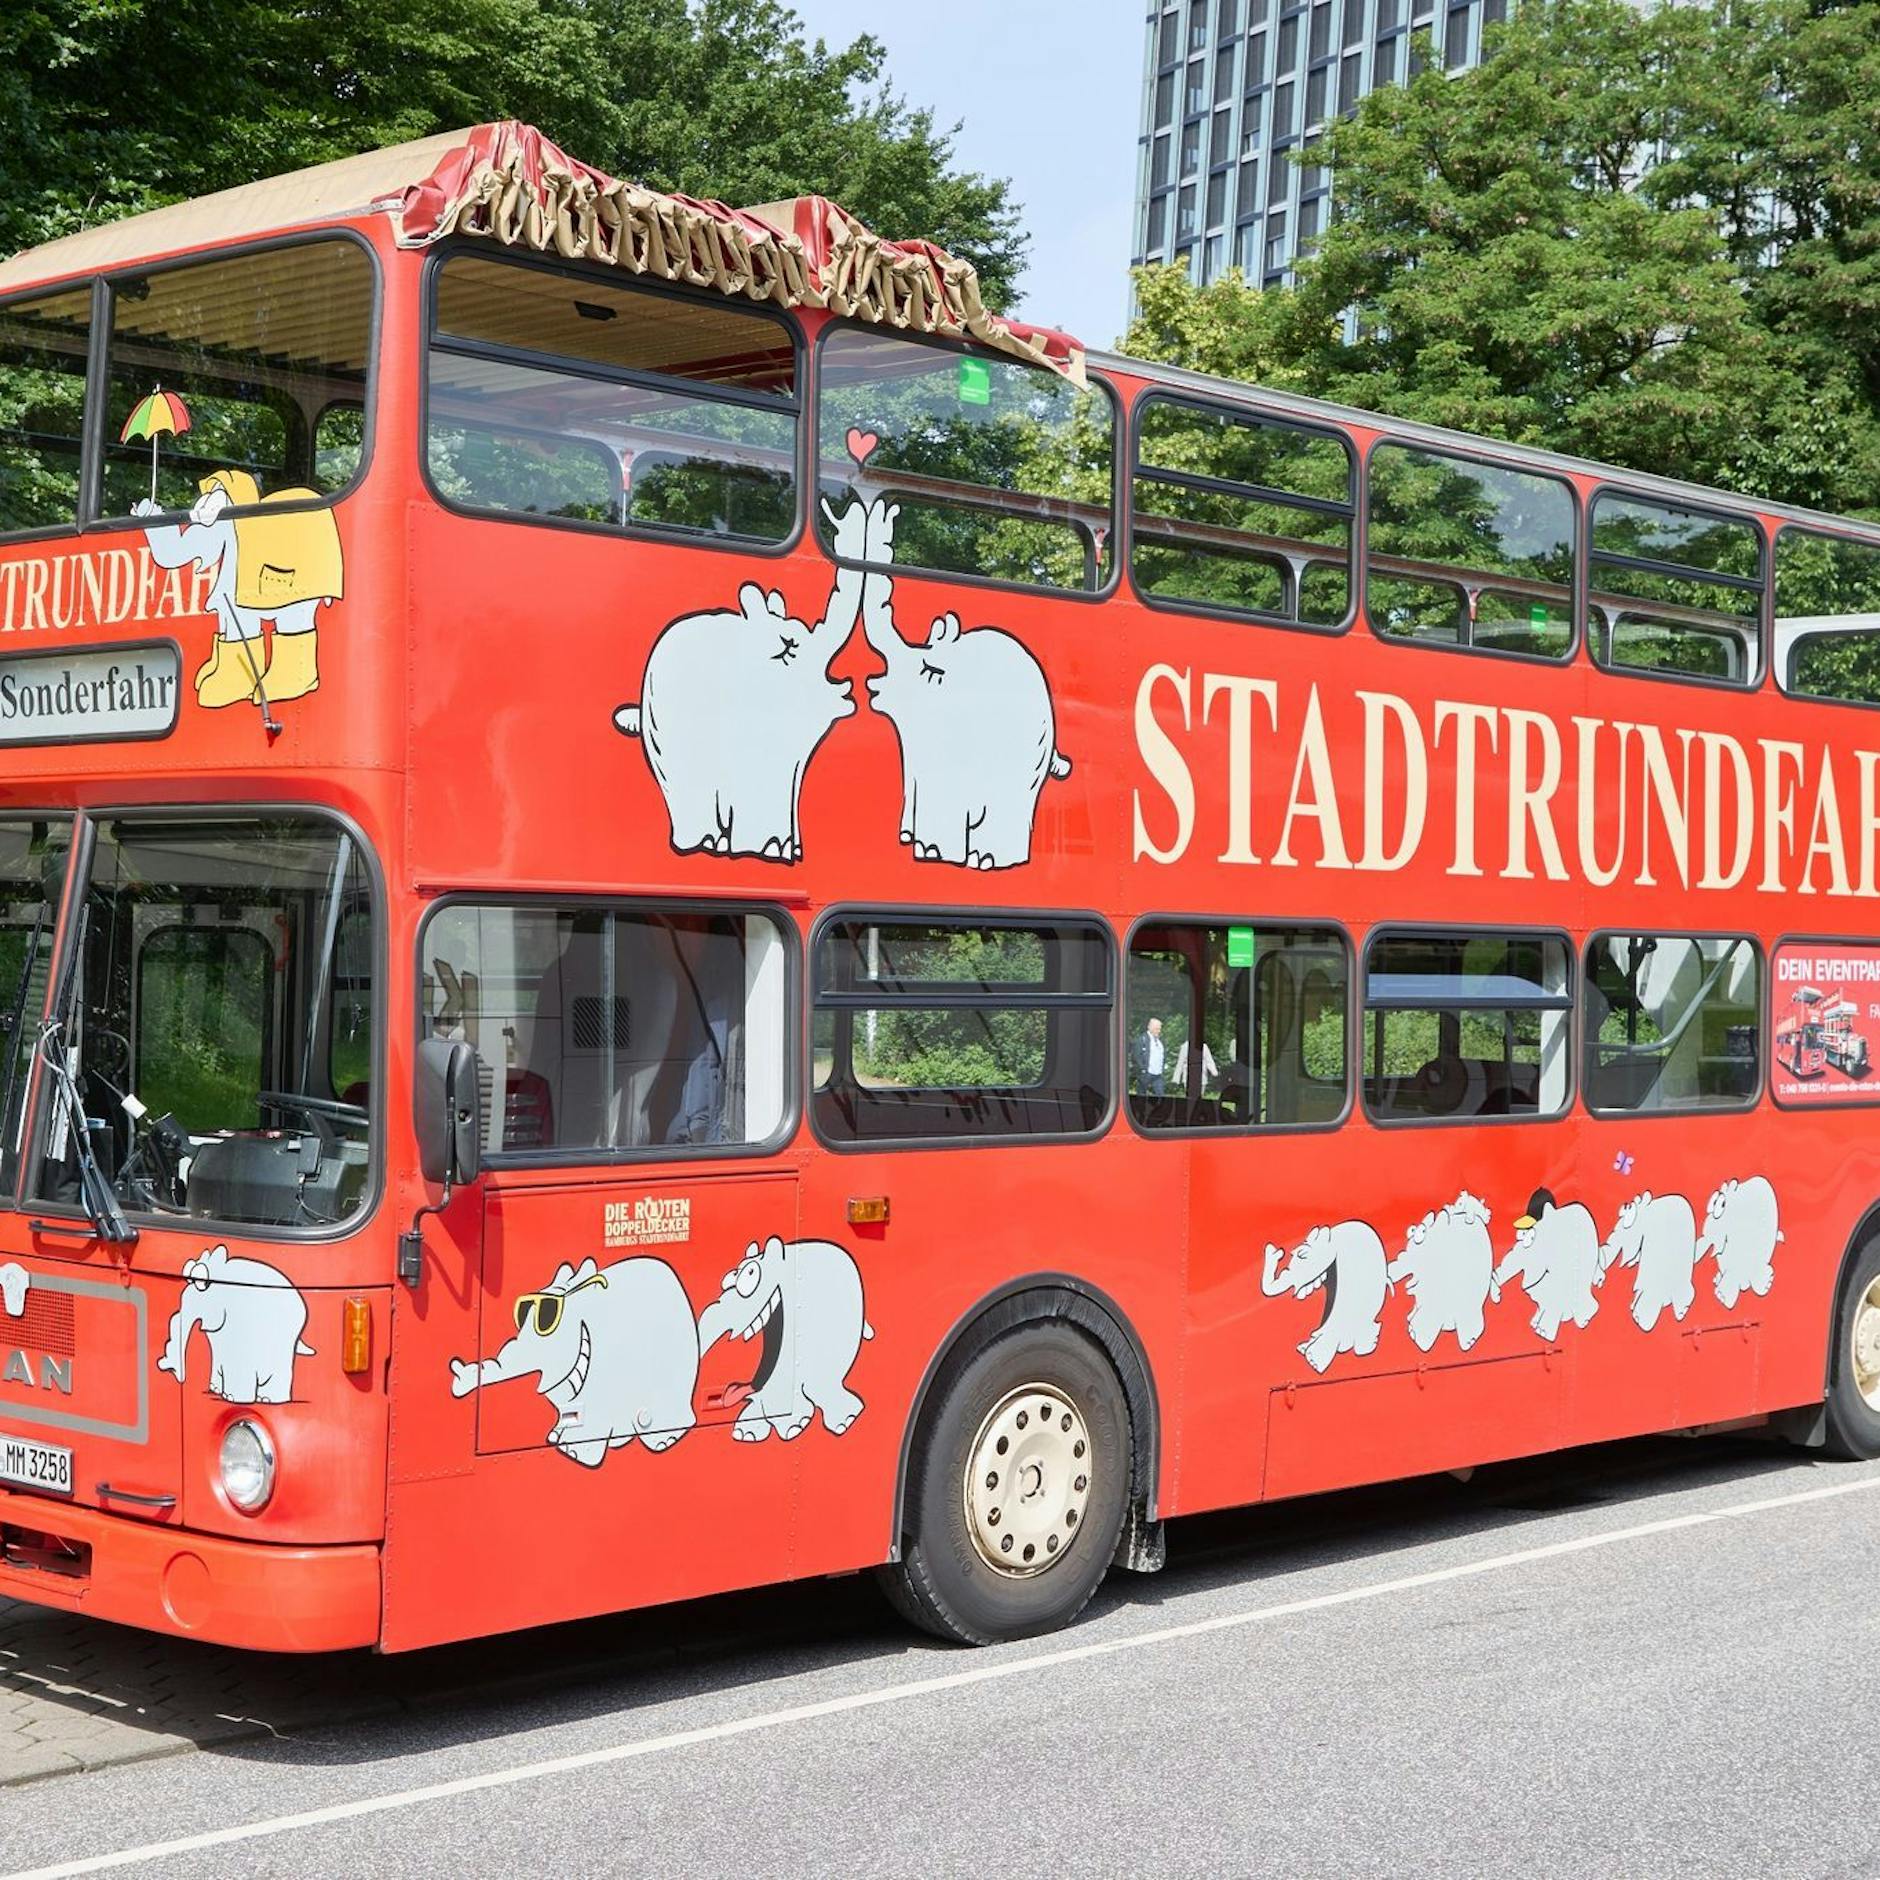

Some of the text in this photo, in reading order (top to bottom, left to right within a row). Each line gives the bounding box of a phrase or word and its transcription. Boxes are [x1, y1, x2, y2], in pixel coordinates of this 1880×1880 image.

[1, 665, 177, 719] Sonderfahr
[1779, 959, 1812, 981] DEIN
[605, 1202, 629, 1221] DIE
[605, 1217, 690, 1236] DOPPELDECKER
[6, 1443, 68, 1485] MM 3258
